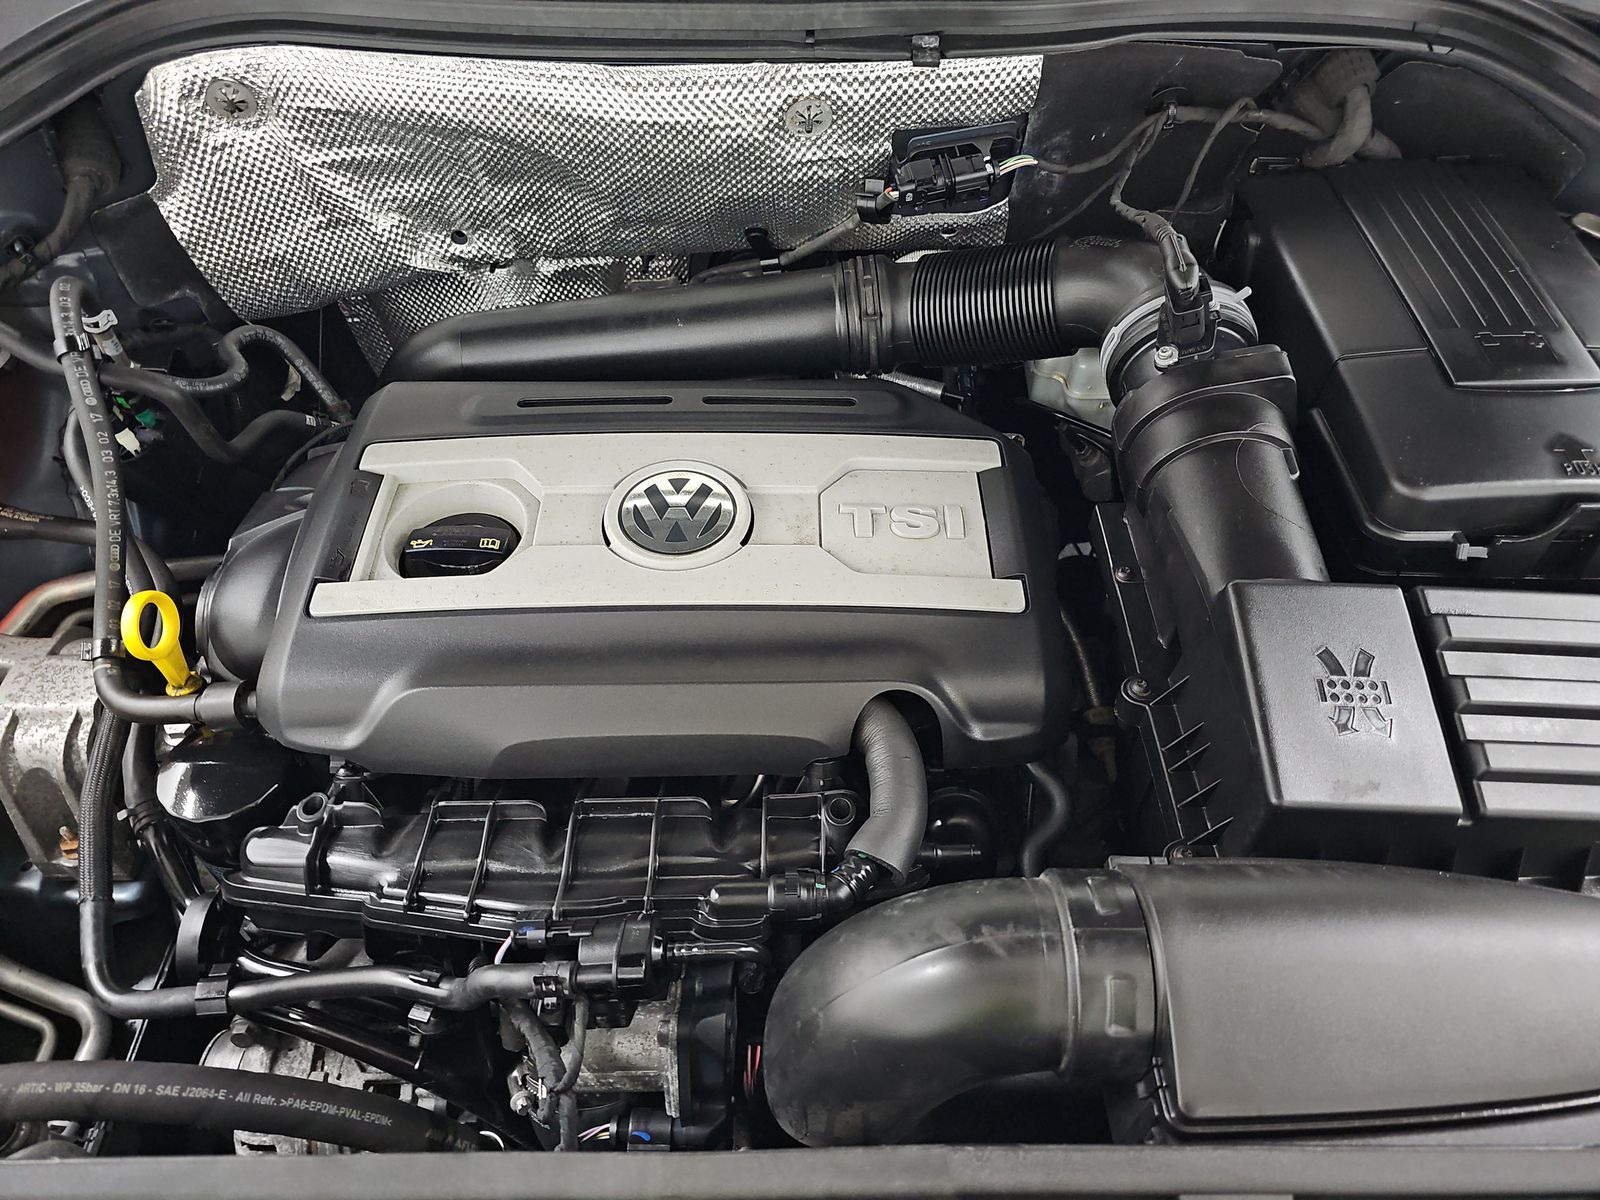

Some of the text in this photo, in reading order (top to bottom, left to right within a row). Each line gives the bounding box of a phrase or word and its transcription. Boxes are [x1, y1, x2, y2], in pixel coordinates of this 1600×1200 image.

[74, 365, 90, 378] DE
[89, 412, 104, 423] 17
[96, 431, 110, 444] 02
[101, 450, 114, 463] 03
[108, 508, 121, 526] VRT
[838, 503, 966, 540] TSI
[109, 529, 122, 542] DE
[54, 1082, 72, 1093] WP
[73, 1082, 104, 1093] 35bar
[112, 1083, 130, 1094] DN
[133, 1084, 147, 1095] 16
[155, 1085, 181, 1097] SAE
[182, 1086, 227, 1100] J2064-E
[235, 1091, 252, 1103] All
